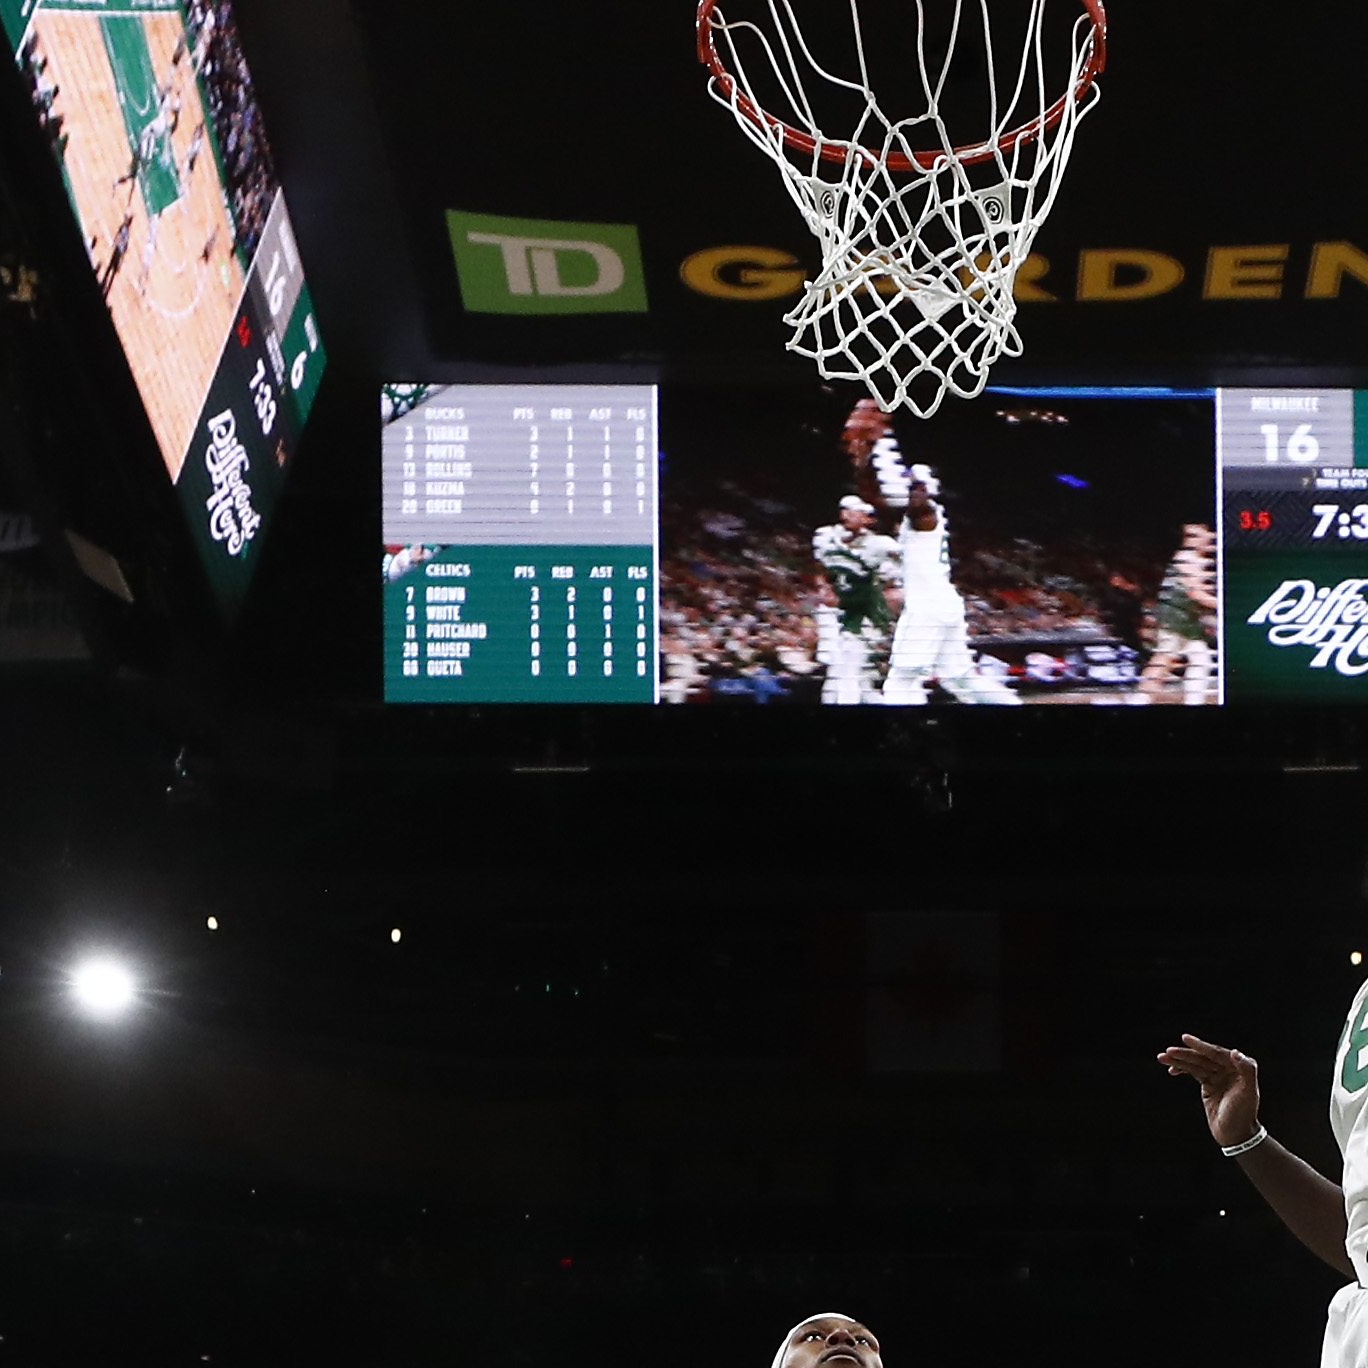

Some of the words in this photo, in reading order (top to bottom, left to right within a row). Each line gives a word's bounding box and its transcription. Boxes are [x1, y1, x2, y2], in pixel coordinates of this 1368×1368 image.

[466, 231, 625, 296] TD
[290, 350, 309, 390] 6
[513, 407, 534, 420] PTS
[589, 407, 612, 420] AST
[1260, 424, 1320, 463] 16
[1239, 511, 1272, 530] 3.5
[426, 564, 470, 578] CELTICS
[514, 564, 536, 578] PTS
[552, 564, 574, 578] REB
[590, 564, 614, 578] AST
[628, 564, 648, 578] FLS
[405, 587, 414, 603] 7
[531, 587, 540, 603] 3
[566, 587, 576, 603] 2
[426, 604, 460, 621] WHITE
[531, 604, 540, 621] 3
[426, 623, 487, 639] PRITCHARD
